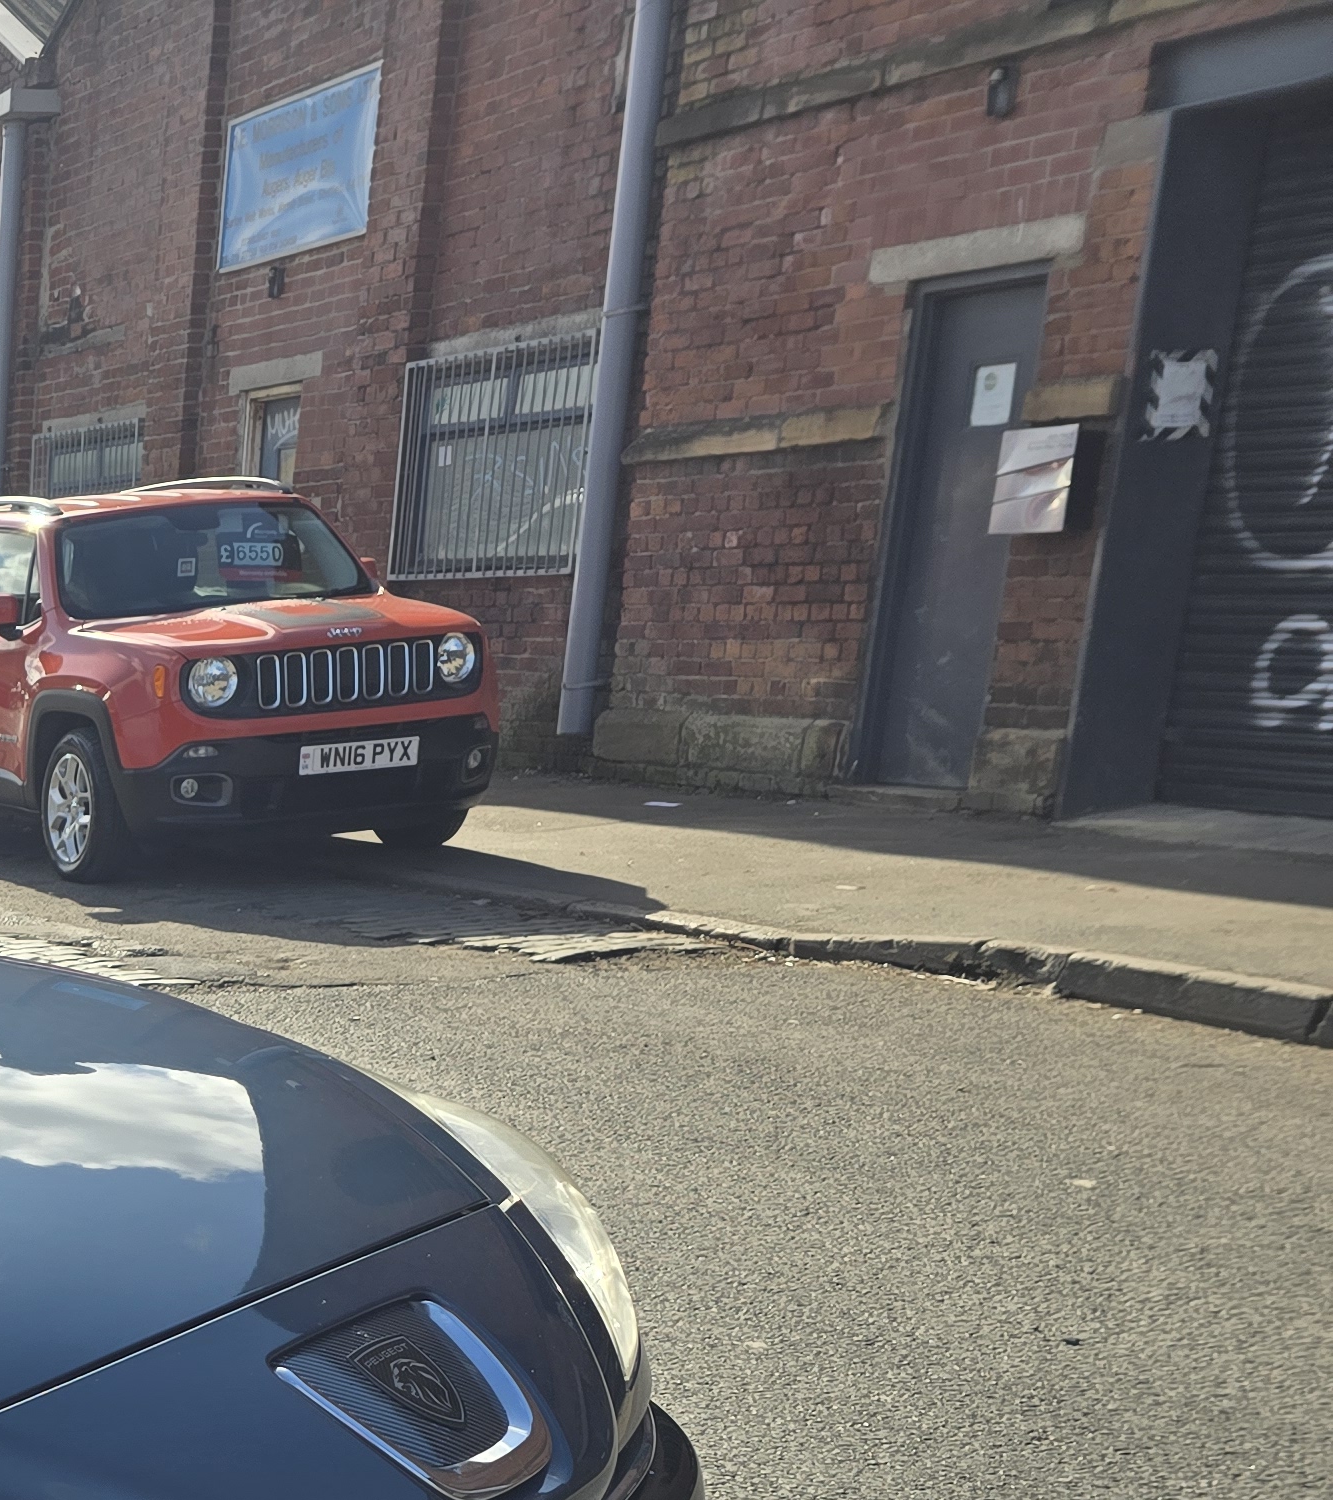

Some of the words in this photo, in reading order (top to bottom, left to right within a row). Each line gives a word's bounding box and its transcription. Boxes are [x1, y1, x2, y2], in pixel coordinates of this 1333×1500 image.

[221, 544, 282, 563] £6550
[320, 745, 367, 768] WN16
[372, 740, 413, 764] PYX
[364, 1343, 408, 1368] PEUGEOT
